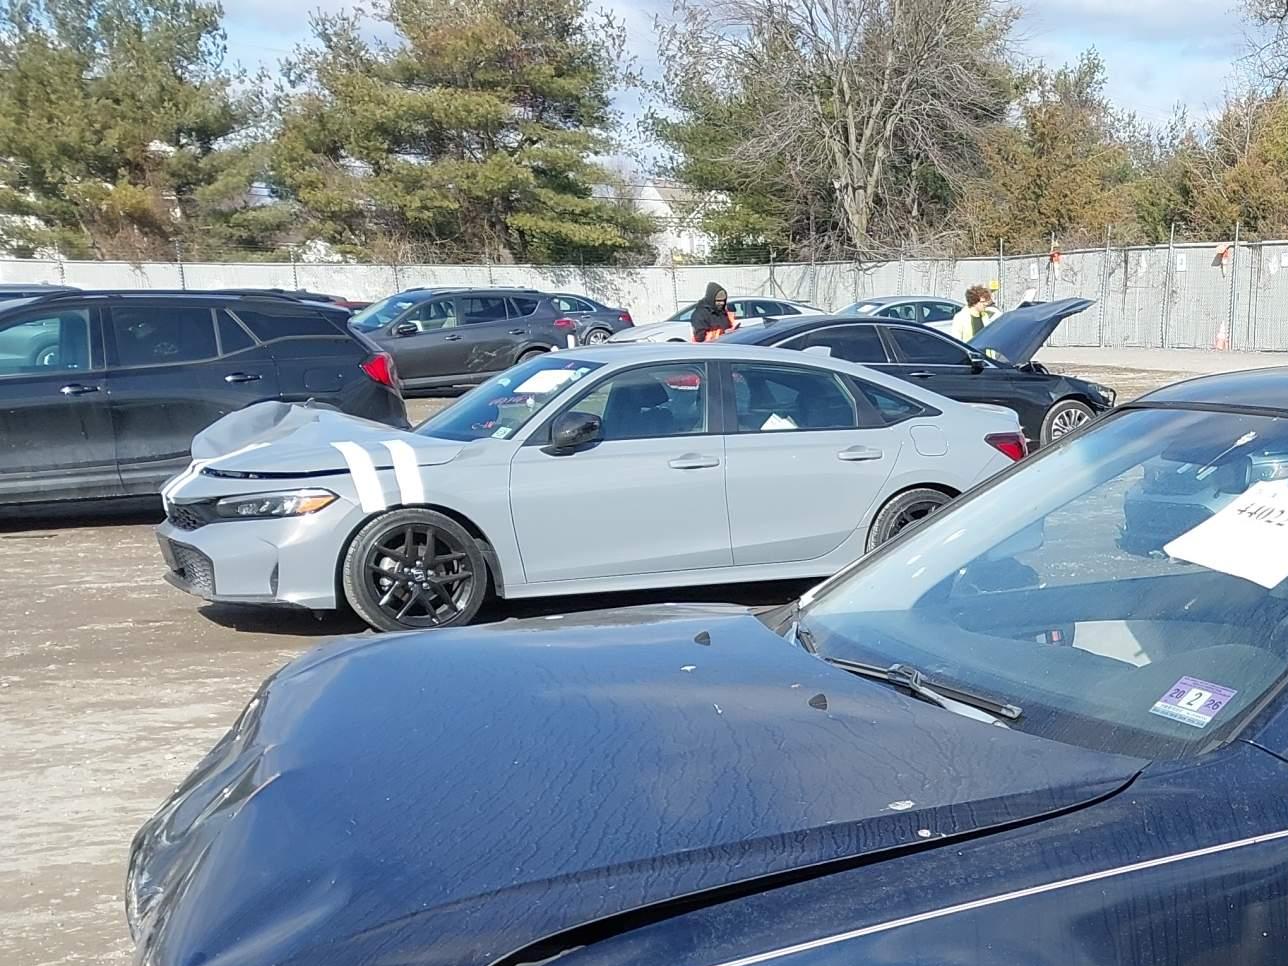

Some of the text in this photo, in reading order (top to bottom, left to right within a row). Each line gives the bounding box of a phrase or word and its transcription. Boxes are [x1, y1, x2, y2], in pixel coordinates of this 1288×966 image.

[1169, 687, 1186, 700] 20
[1186, 691, 1203, 707] 2
[1205, 698, 1223, 711] 26
